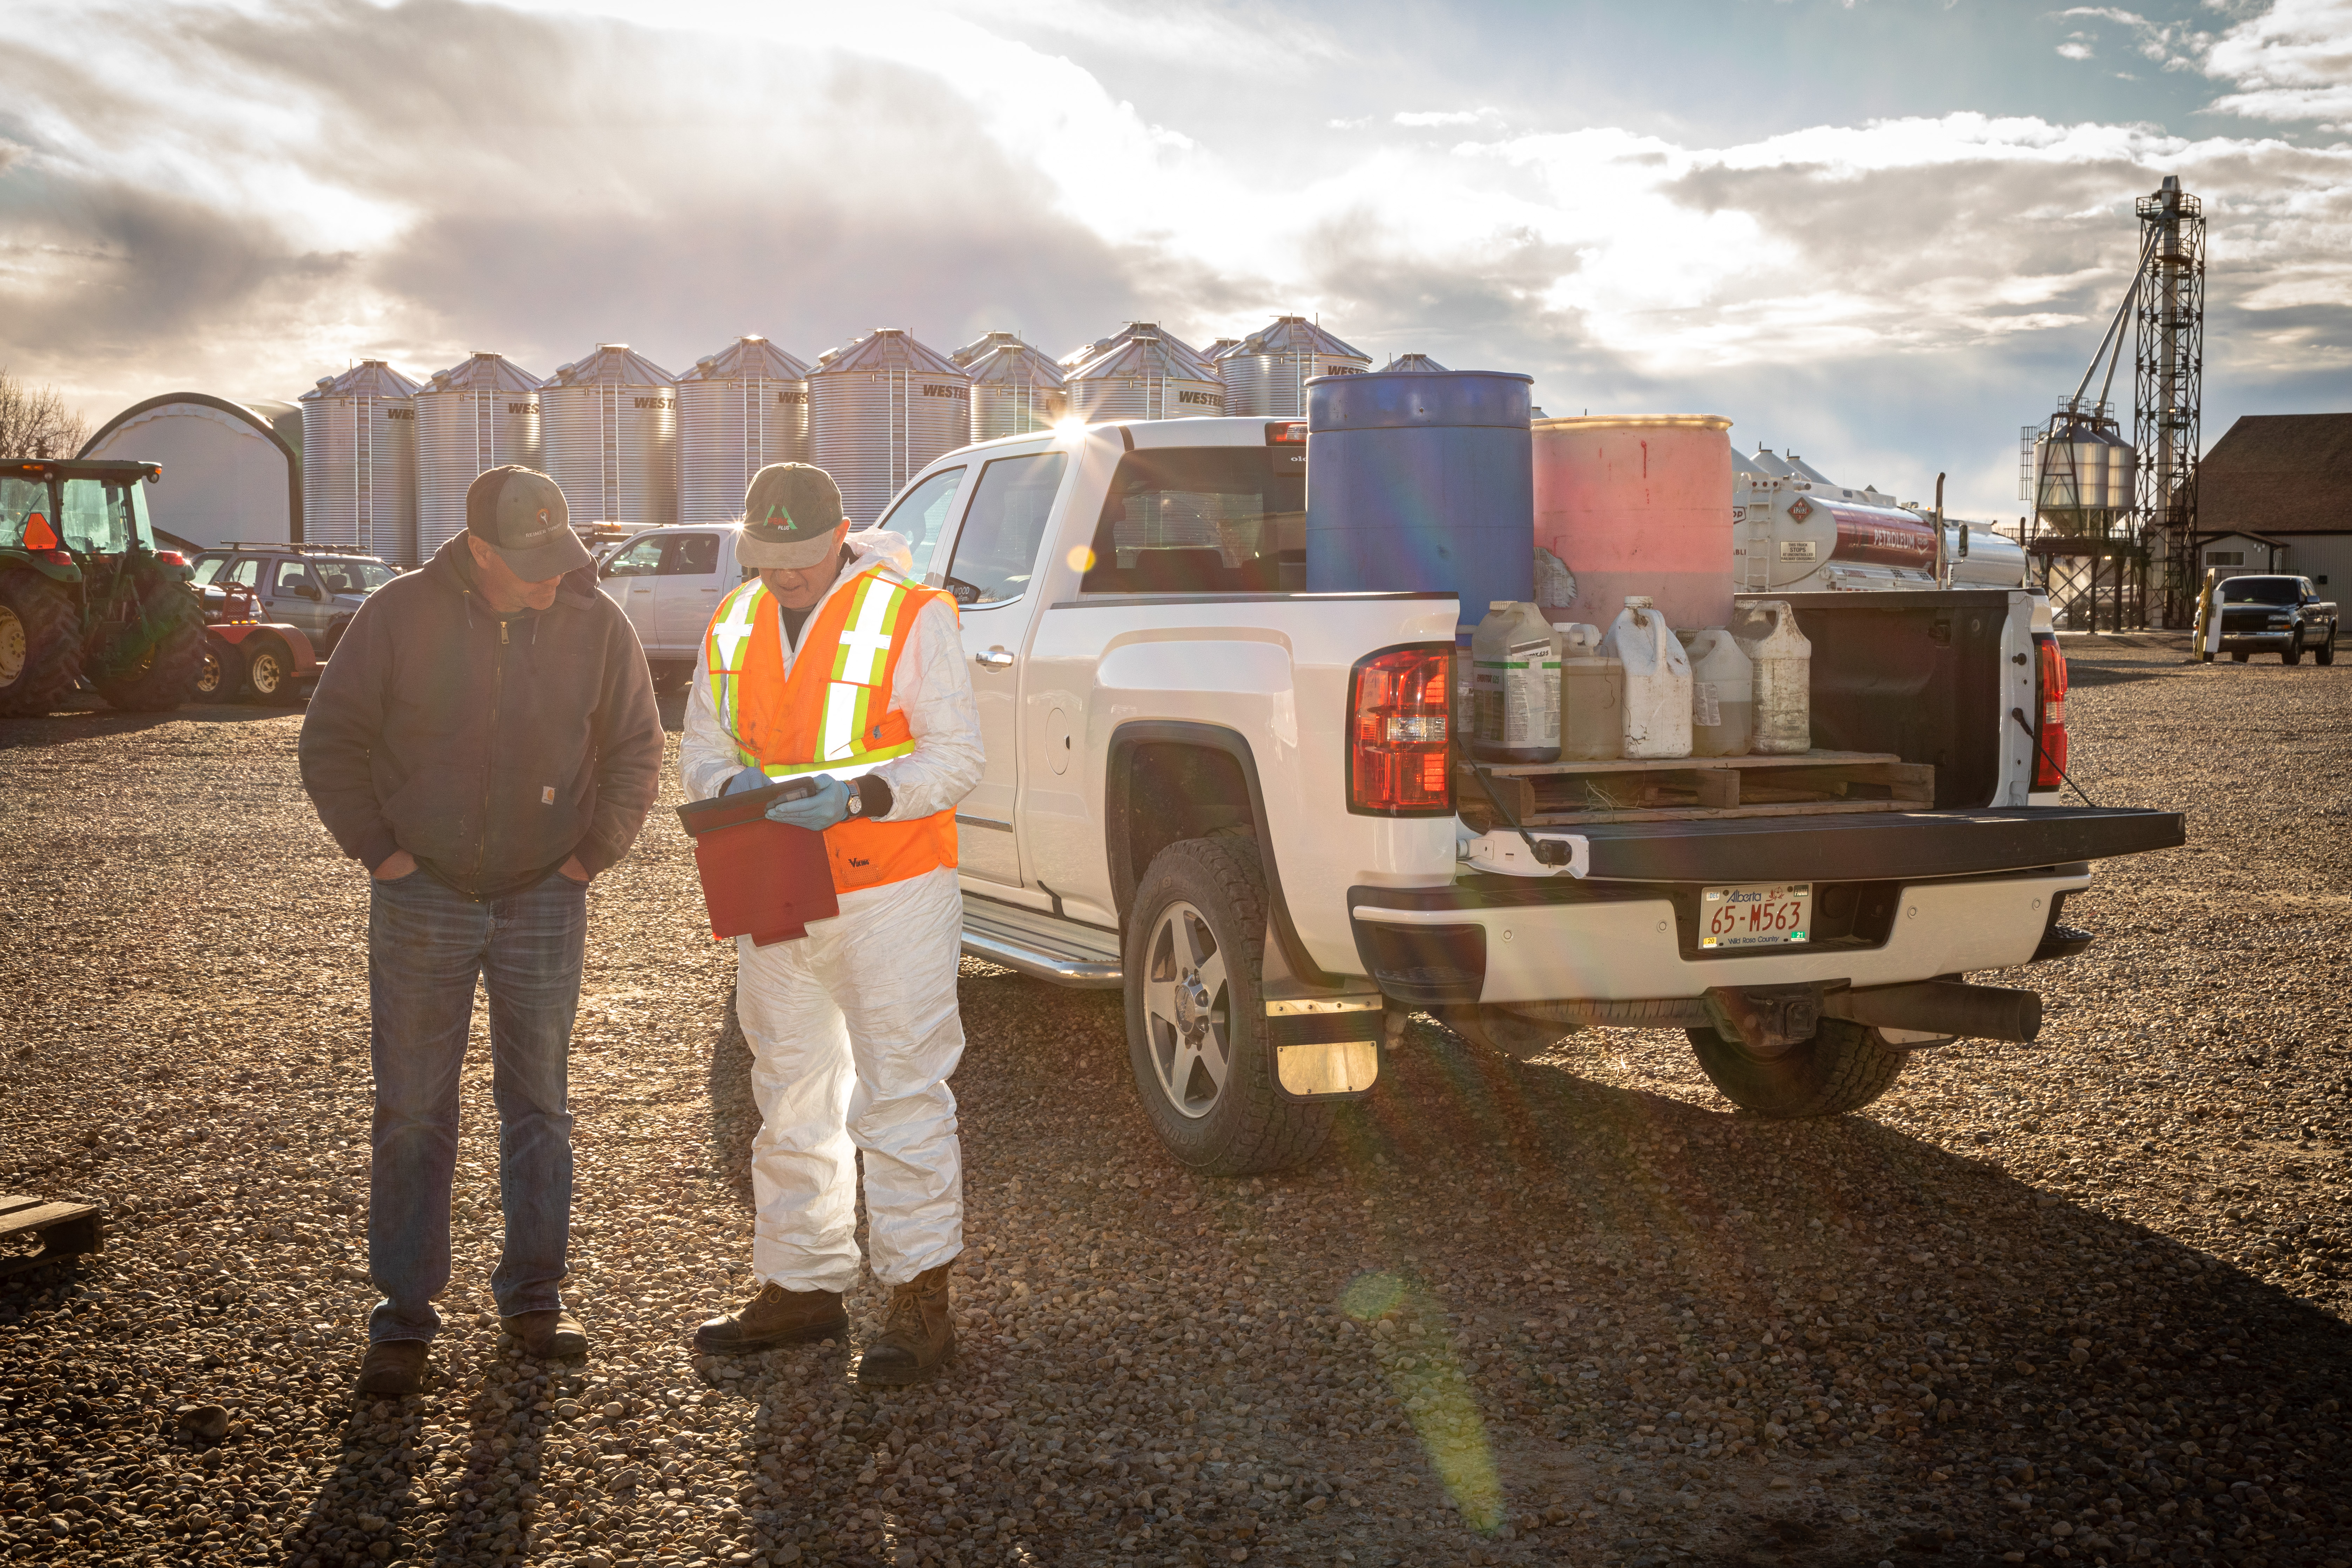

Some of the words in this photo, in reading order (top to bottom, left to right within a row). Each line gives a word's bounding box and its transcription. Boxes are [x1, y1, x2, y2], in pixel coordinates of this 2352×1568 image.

[1180, 391, 1223, 407] WESTEE
[509, 403, 539, 414] WES
[526, 529, 546, 538] REIMER
[1874, 529, 1914, 549] PETROLEUM
[954, 587, 970, 595] WOOD
[848, 858, 869, 868] VIKING
[1726, 889, 1762, 903] Alberta
[1711, 901, 1801, 934] 65-M563
